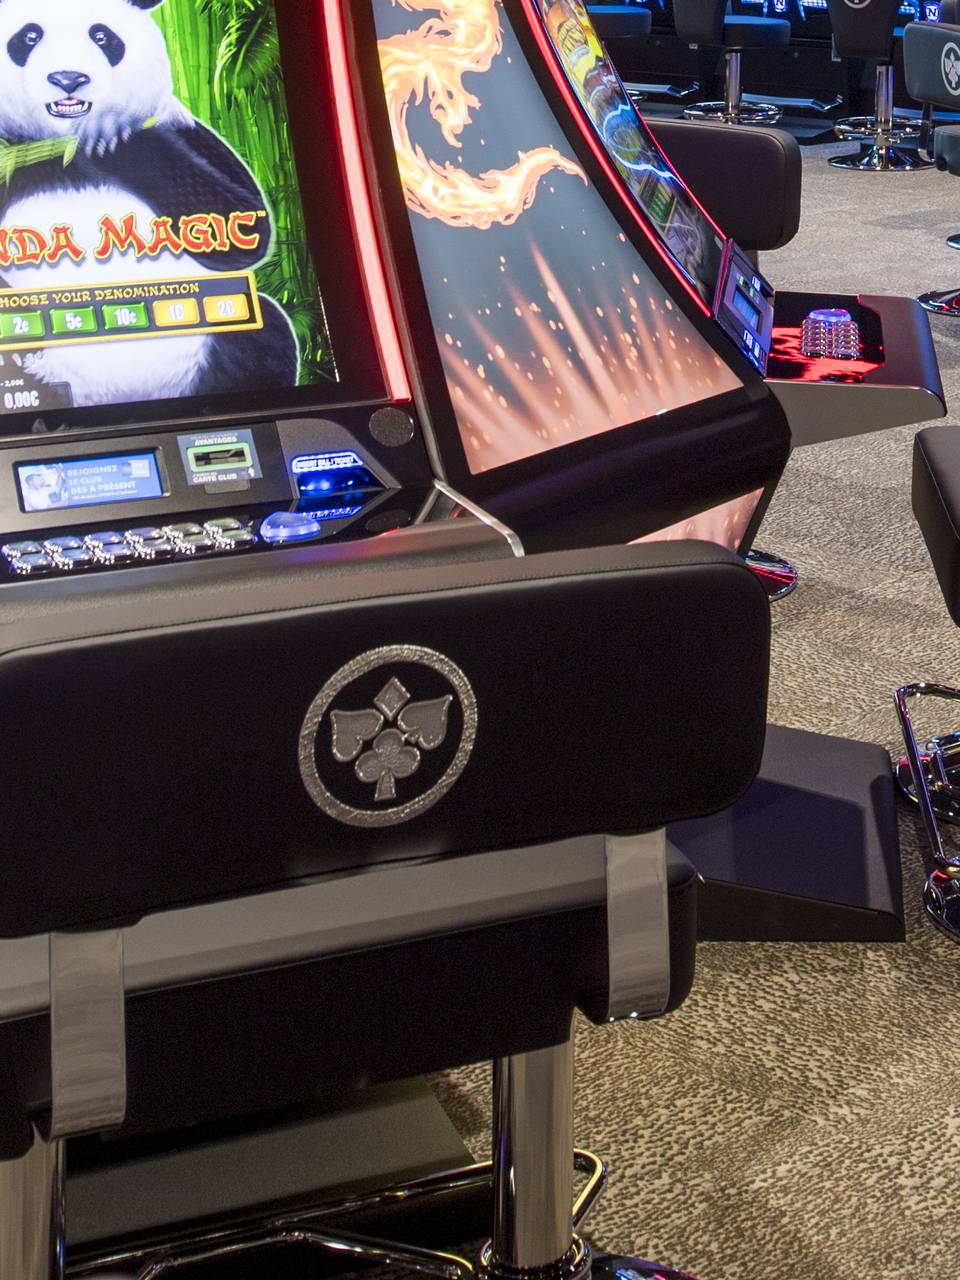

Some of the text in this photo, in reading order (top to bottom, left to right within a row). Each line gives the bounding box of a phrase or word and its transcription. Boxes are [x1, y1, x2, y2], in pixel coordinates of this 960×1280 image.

[94, 211, 261, 259] MAGIC
[52, 291, 92, 304] YOUR
[95, 282, 200, 302] DENOMINATION
[4, 391, 39, 410] 0,00€
